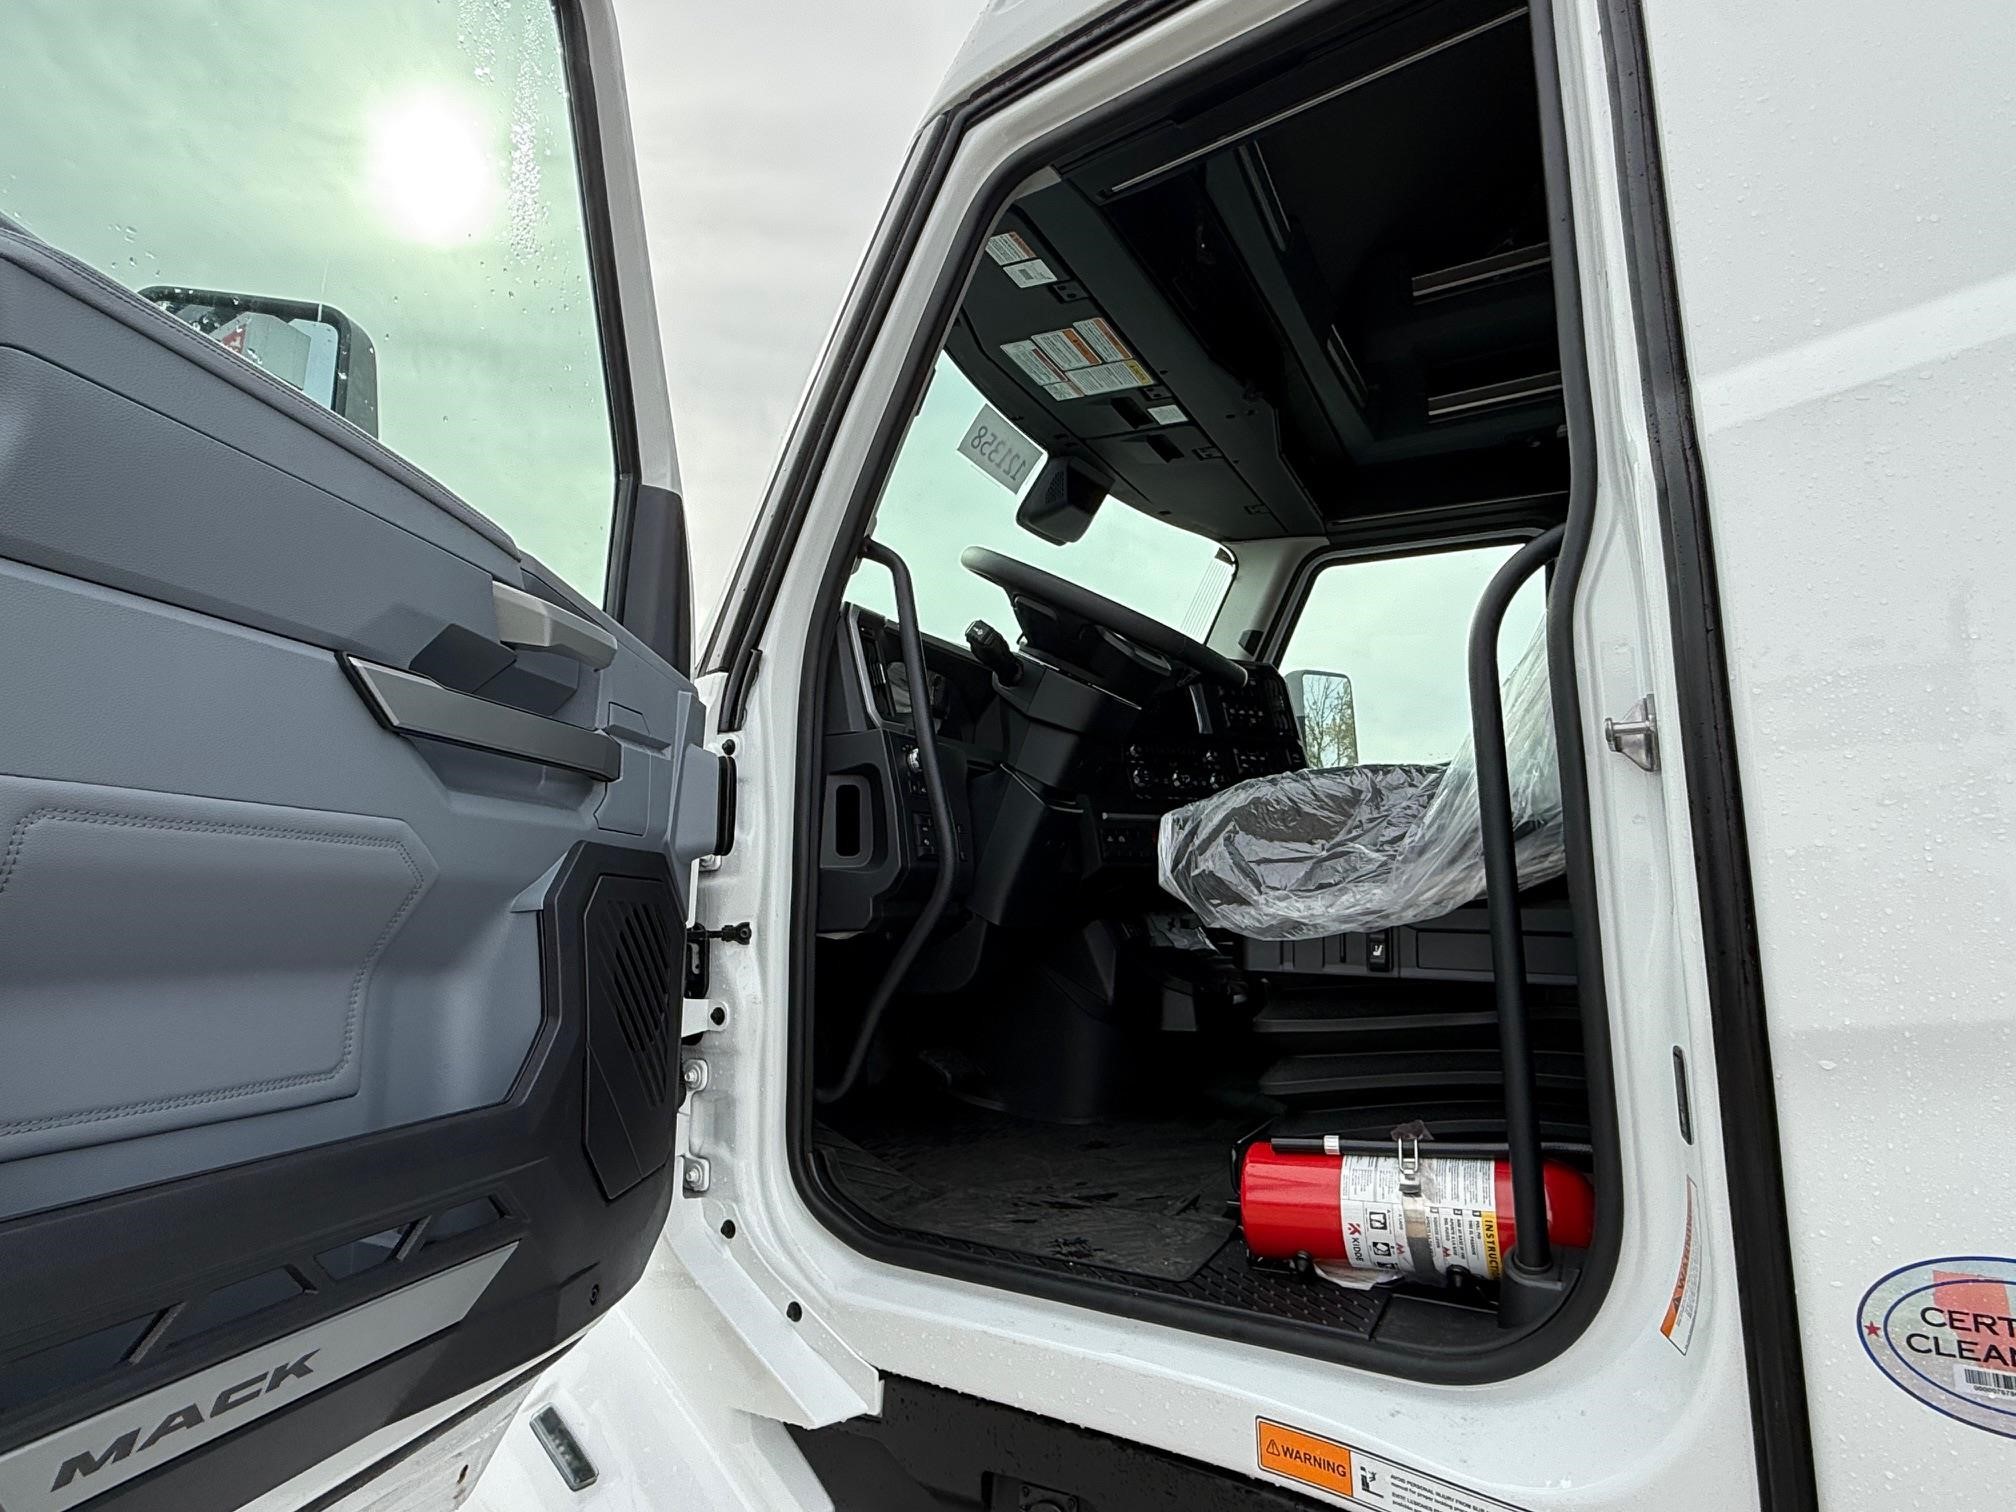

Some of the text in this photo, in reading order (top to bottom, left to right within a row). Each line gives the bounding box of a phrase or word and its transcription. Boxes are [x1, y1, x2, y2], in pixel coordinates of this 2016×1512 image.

[1485, 1220, 1500, 1281] INSTRUCTI
[50, 1348, 321, 1493] MACK
[1281, 1444, 1347, 1478] WARNING
